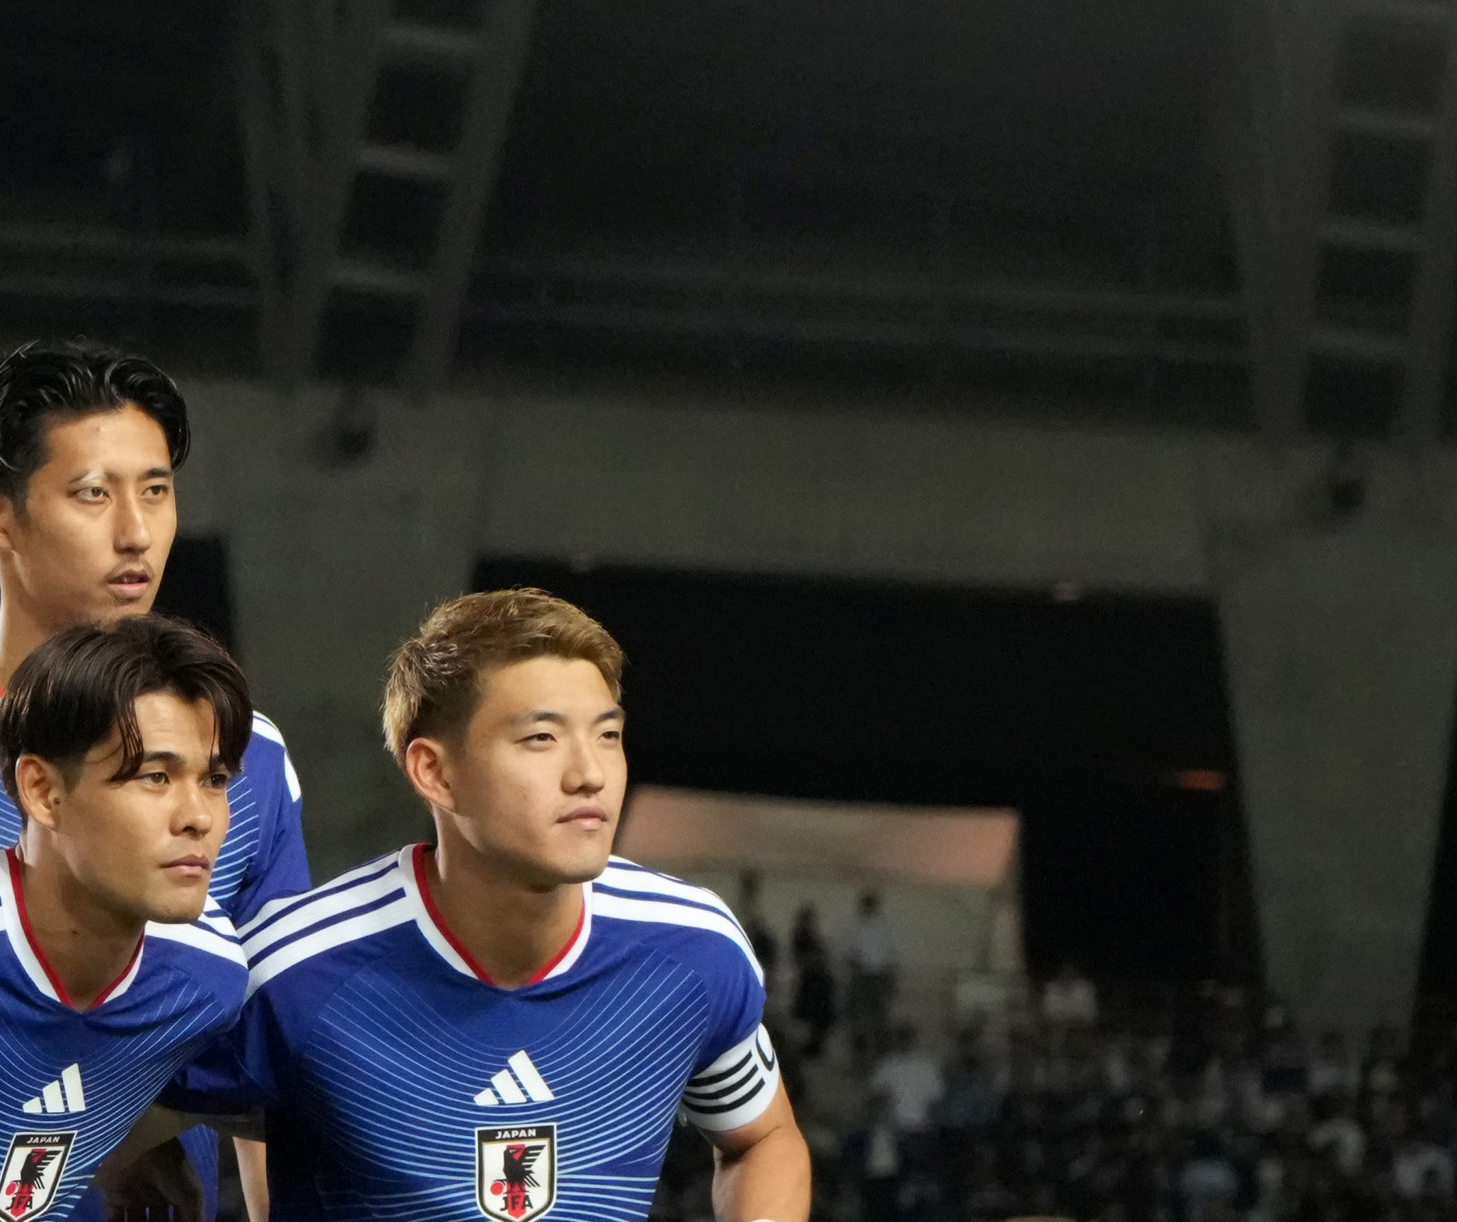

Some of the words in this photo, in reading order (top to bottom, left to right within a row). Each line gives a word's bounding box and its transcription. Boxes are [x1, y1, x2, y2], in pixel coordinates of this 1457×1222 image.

[27, 1136, 60, 1144] JAPAN
[494, 1129, 536, 1140] JAPAN
[499, 1195, 533, 1211] JFA
